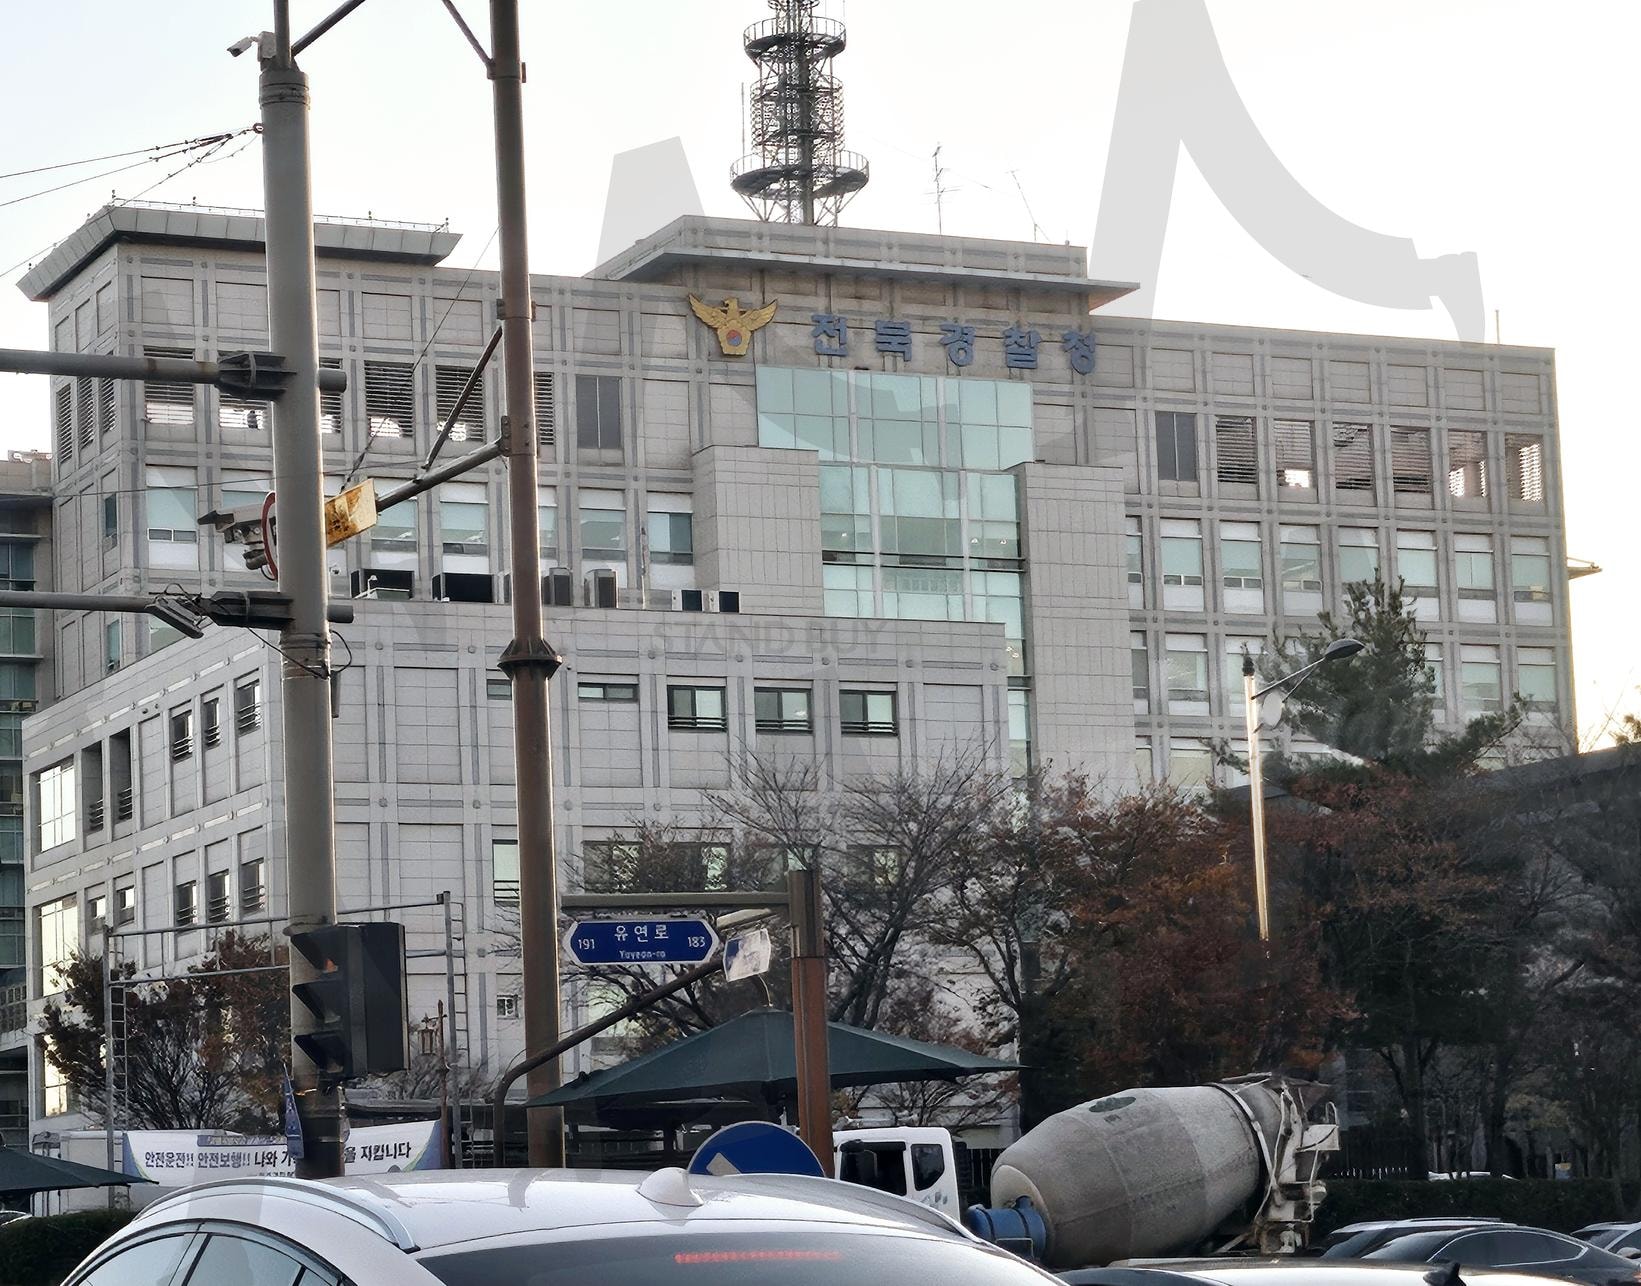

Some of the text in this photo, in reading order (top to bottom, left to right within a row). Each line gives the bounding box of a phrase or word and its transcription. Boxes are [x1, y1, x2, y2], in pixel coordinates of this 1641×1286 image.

[811, 313, 1097, 376] 전북경찰청
[614, 924, 669, 943] 유연로
[578, 938, 596, 950] 191
[687, 936, 706, 948] 183
[618, 949, 667, 960] Yuyeon-ro
[254, 1150, 278, 1168] 나와
[360, 1141, 412, 1162] 지킵니다
